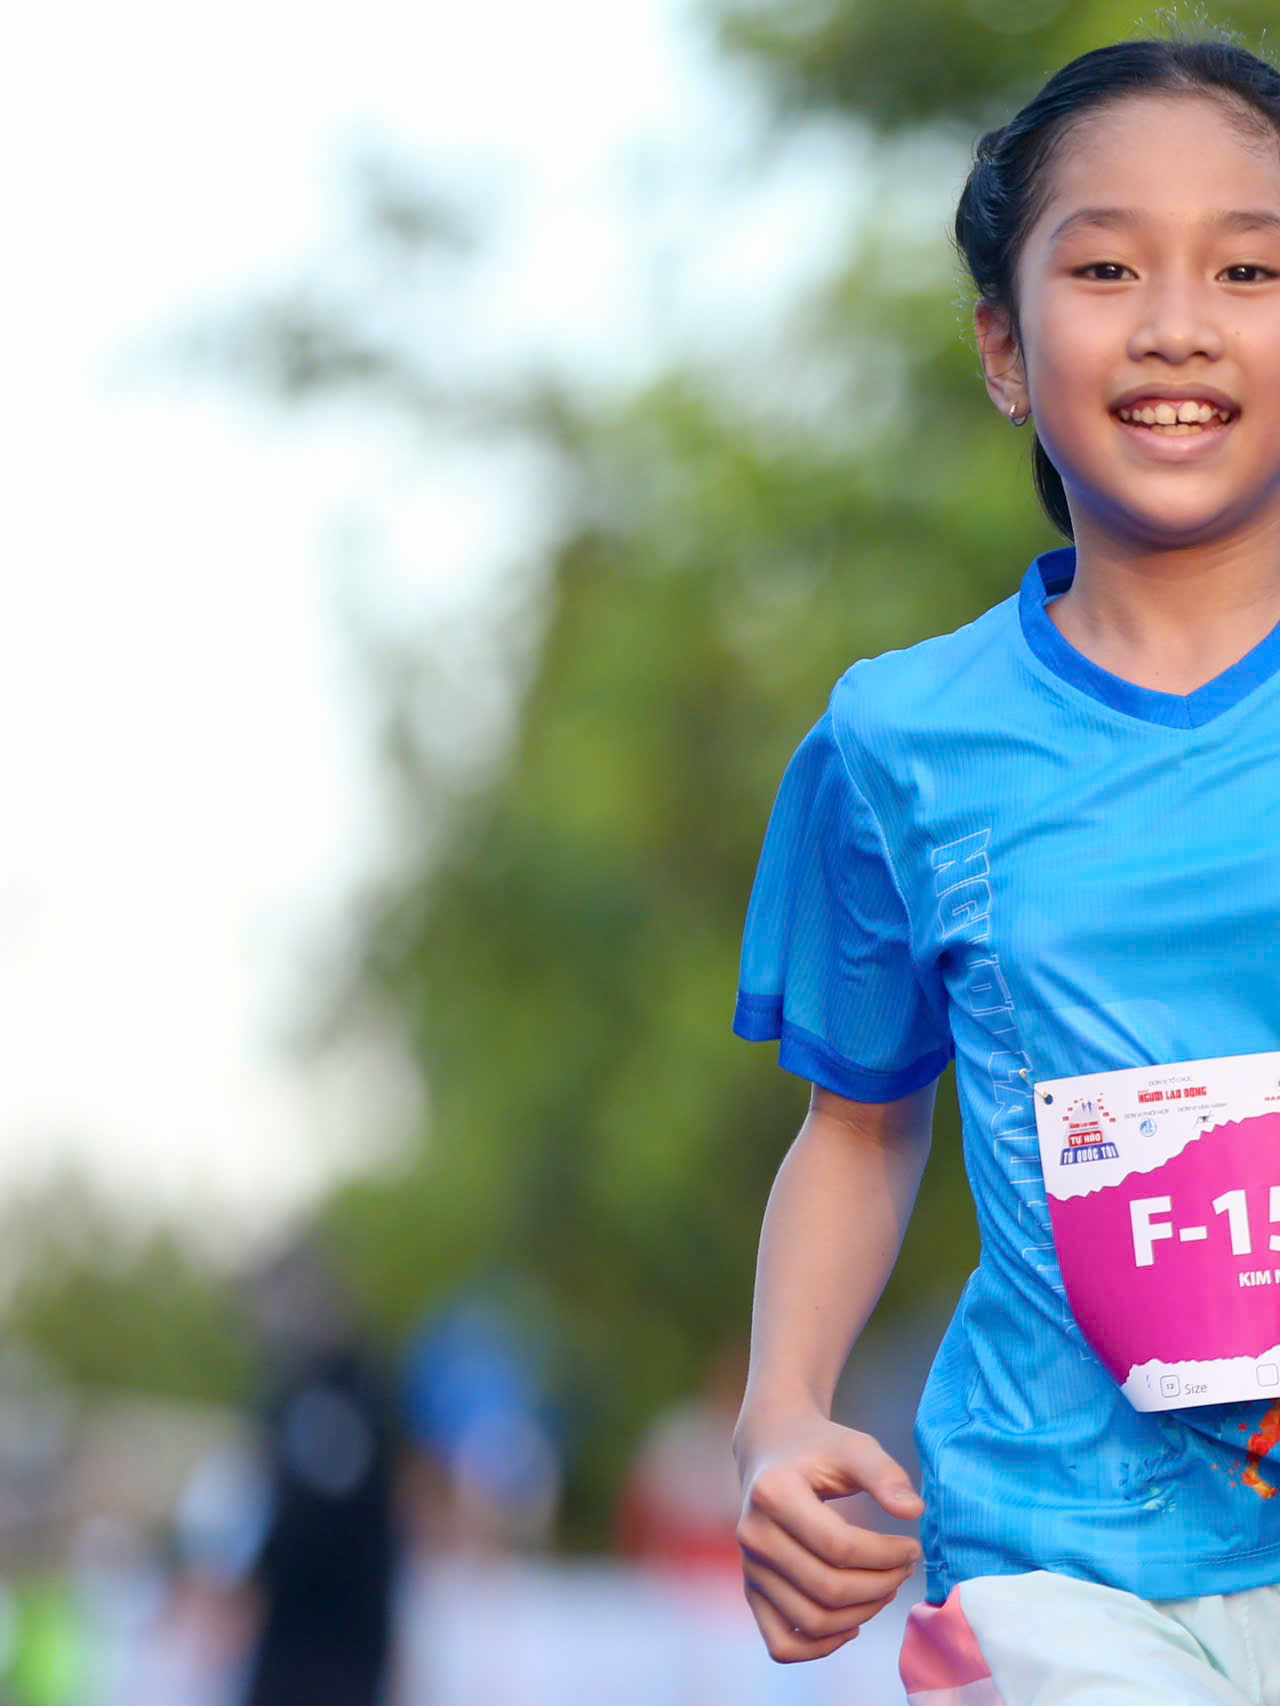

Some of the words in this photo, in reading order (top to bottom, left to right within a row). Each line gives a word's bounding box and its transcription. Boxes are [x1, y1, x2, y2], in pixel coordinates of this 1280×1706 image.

[1165, 1088, 1182, 1100] LAO
[1238, 1270, 1272, 1288] KIM
[1184, 1383, 1208, 1396] Size
